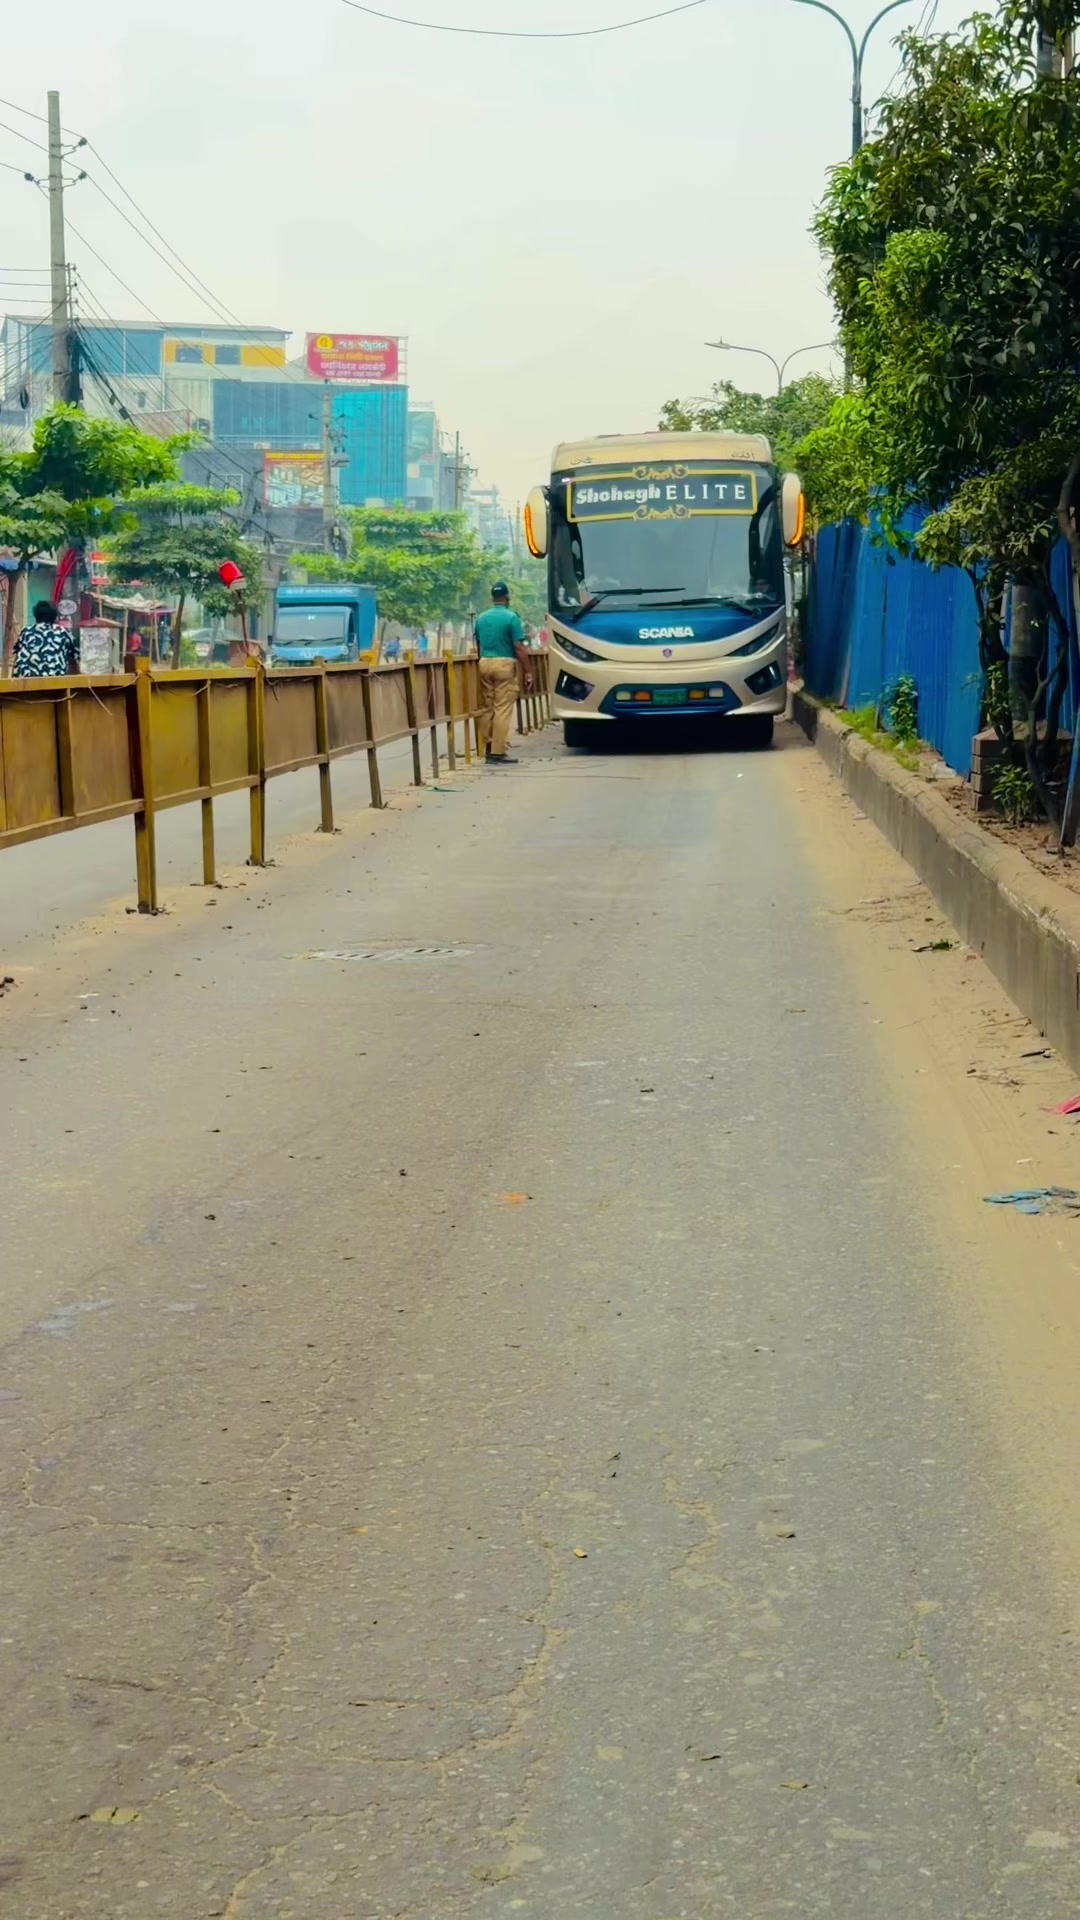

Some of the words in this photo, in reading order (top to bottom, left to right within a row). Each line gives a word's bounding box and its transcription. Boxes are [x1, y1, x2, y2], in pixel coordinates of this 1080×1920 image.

[576, 484, 661, 504] Shohagh
[665, 484, 746, 501] ELITE
[639, 626, 694, 639] SCANIA
